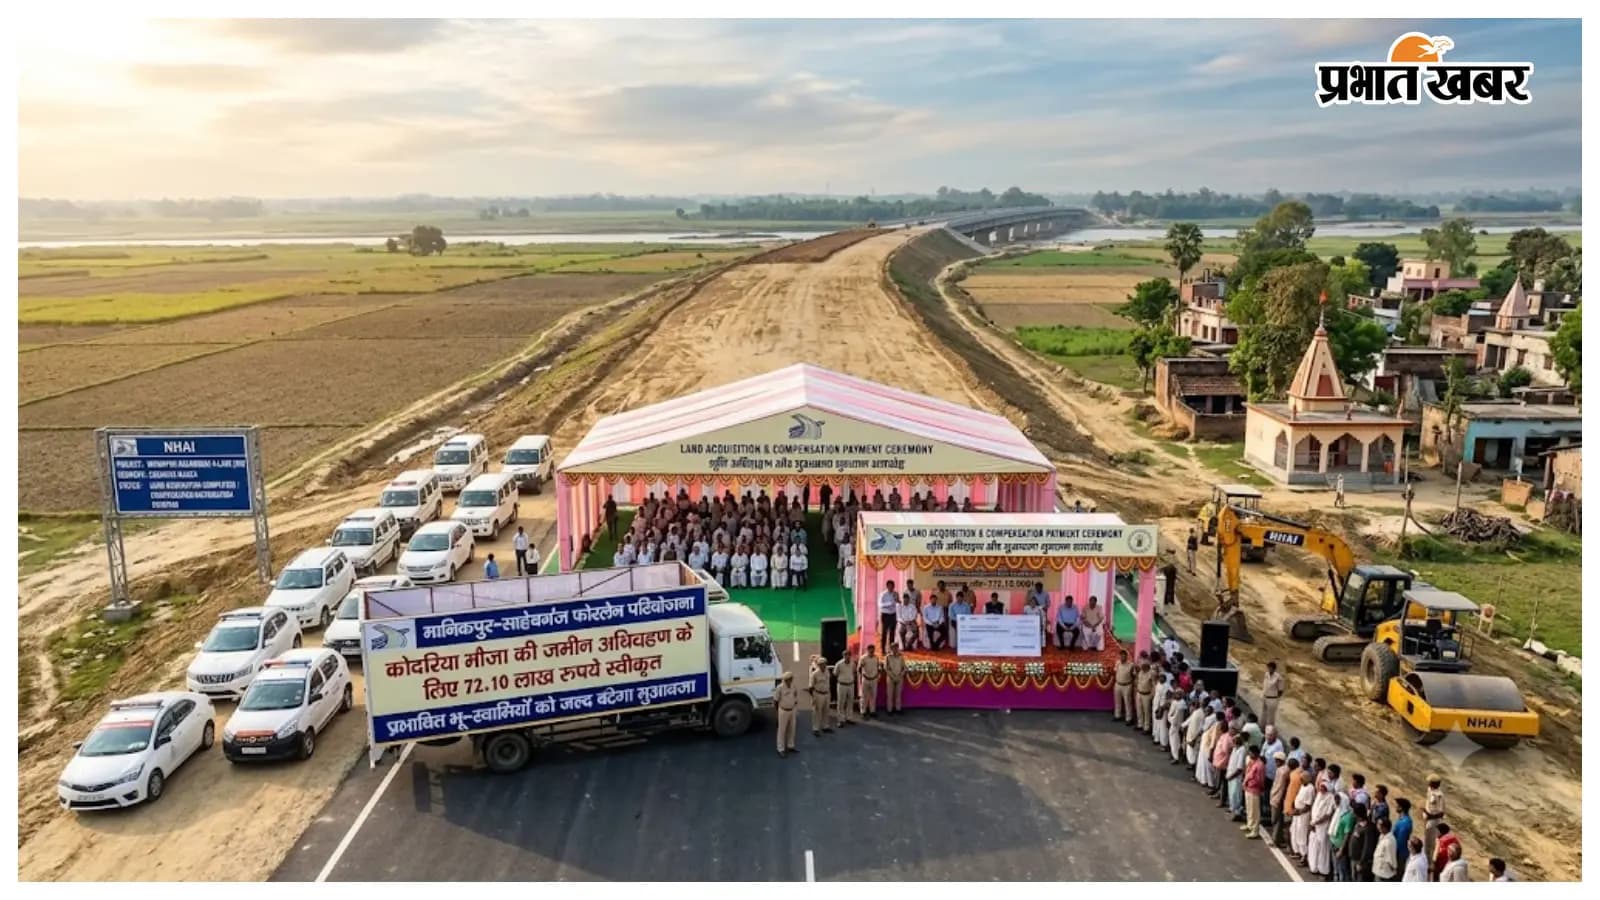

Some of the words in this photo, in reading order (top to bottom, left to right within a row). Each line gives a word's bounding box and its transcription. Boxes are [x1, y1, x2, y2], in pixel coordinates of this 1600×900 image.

[164, 441, 195, 453] NHAI
[680, 444, 703, 454] LAND
[773, 444, 839, 454] COMPENSATION
[842, 444, 882, 454] PAYMENT
[573, 602, 625, 622] फोरलेन
[385, 652, 460, 678] कोदरिया
[514, 640, 538, 661] की
[543, 635, 593, 658] जमीन
[676, 622, 694, 642] के
[422, 678, 459, 700] लिए
[464, 675, 509, 695] 72.10
[514, 669, 554, 689] लाख
[560, 658, 600, 682] रुपये
[386, 711, 446, 737] प्रभावित
[536, 696, 555, 714] को
[560, 694, 593, 711] जल्द
[1467, 717, 1503, 729] NHAI
